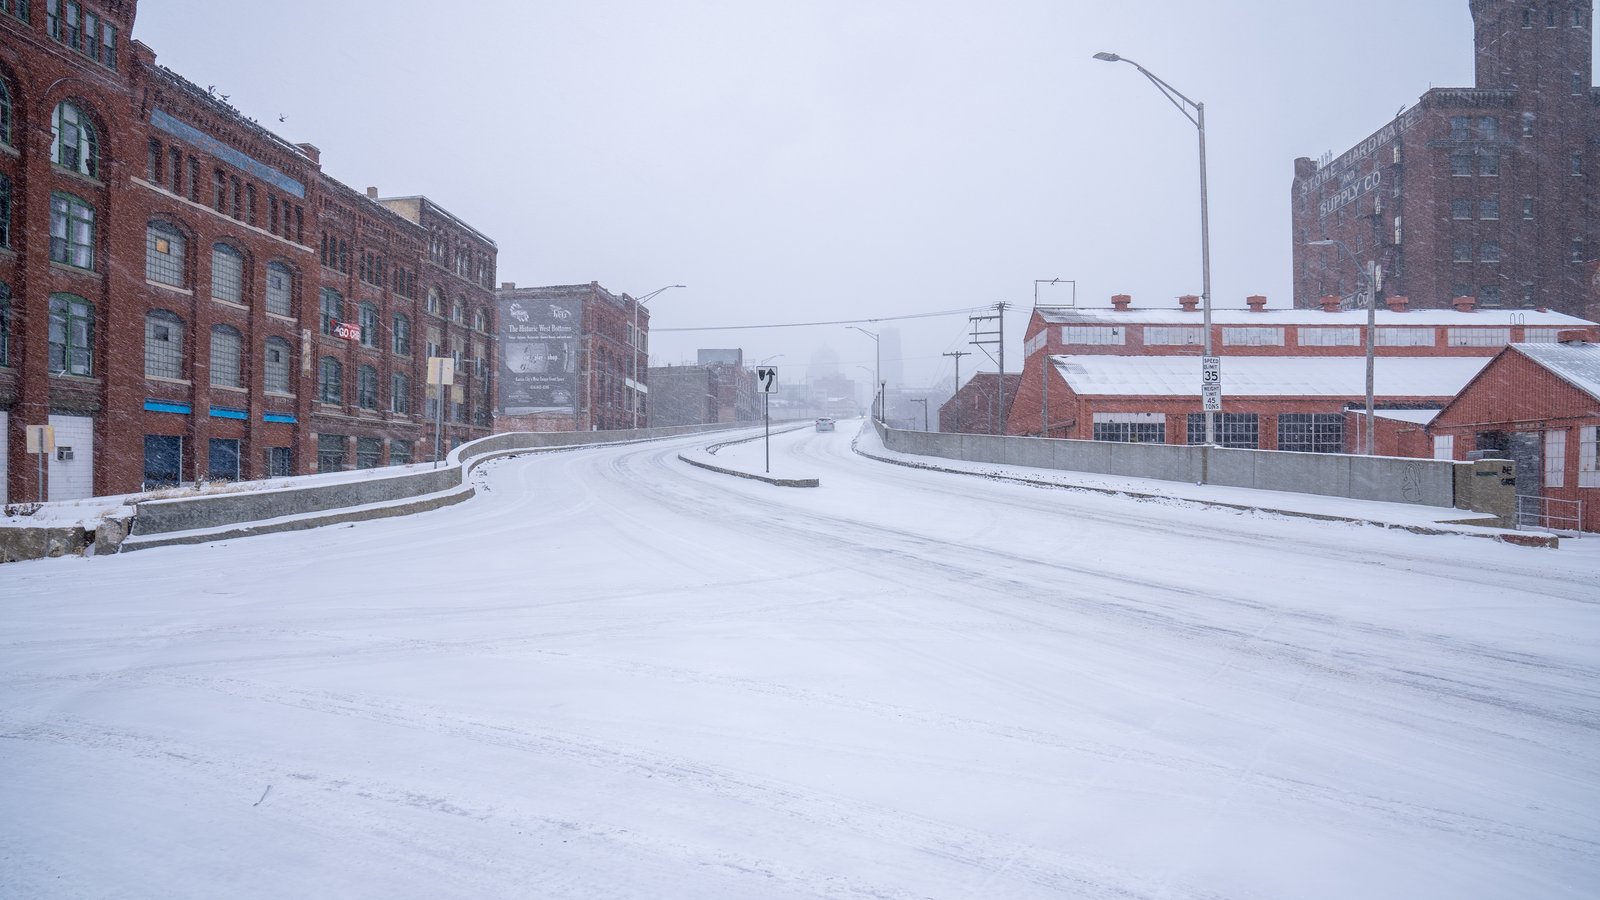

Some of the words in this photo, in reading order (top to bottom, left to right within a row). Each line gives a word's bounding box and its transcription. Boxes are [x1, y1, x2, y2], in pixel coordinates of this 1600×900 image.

[1301, 164, 1338, 196] STOWE
[1344, 113, 1417, 166] HARDWARE
[1319, 184, 1360, 217] SUPPLY
[1364, 170, 1381, 191] CO
[339, 327, 349, 338] GO
[509, 324, 518, 333] The
[539, 324, 551, 332] West
[1204, 370, 1218, 381] 35
